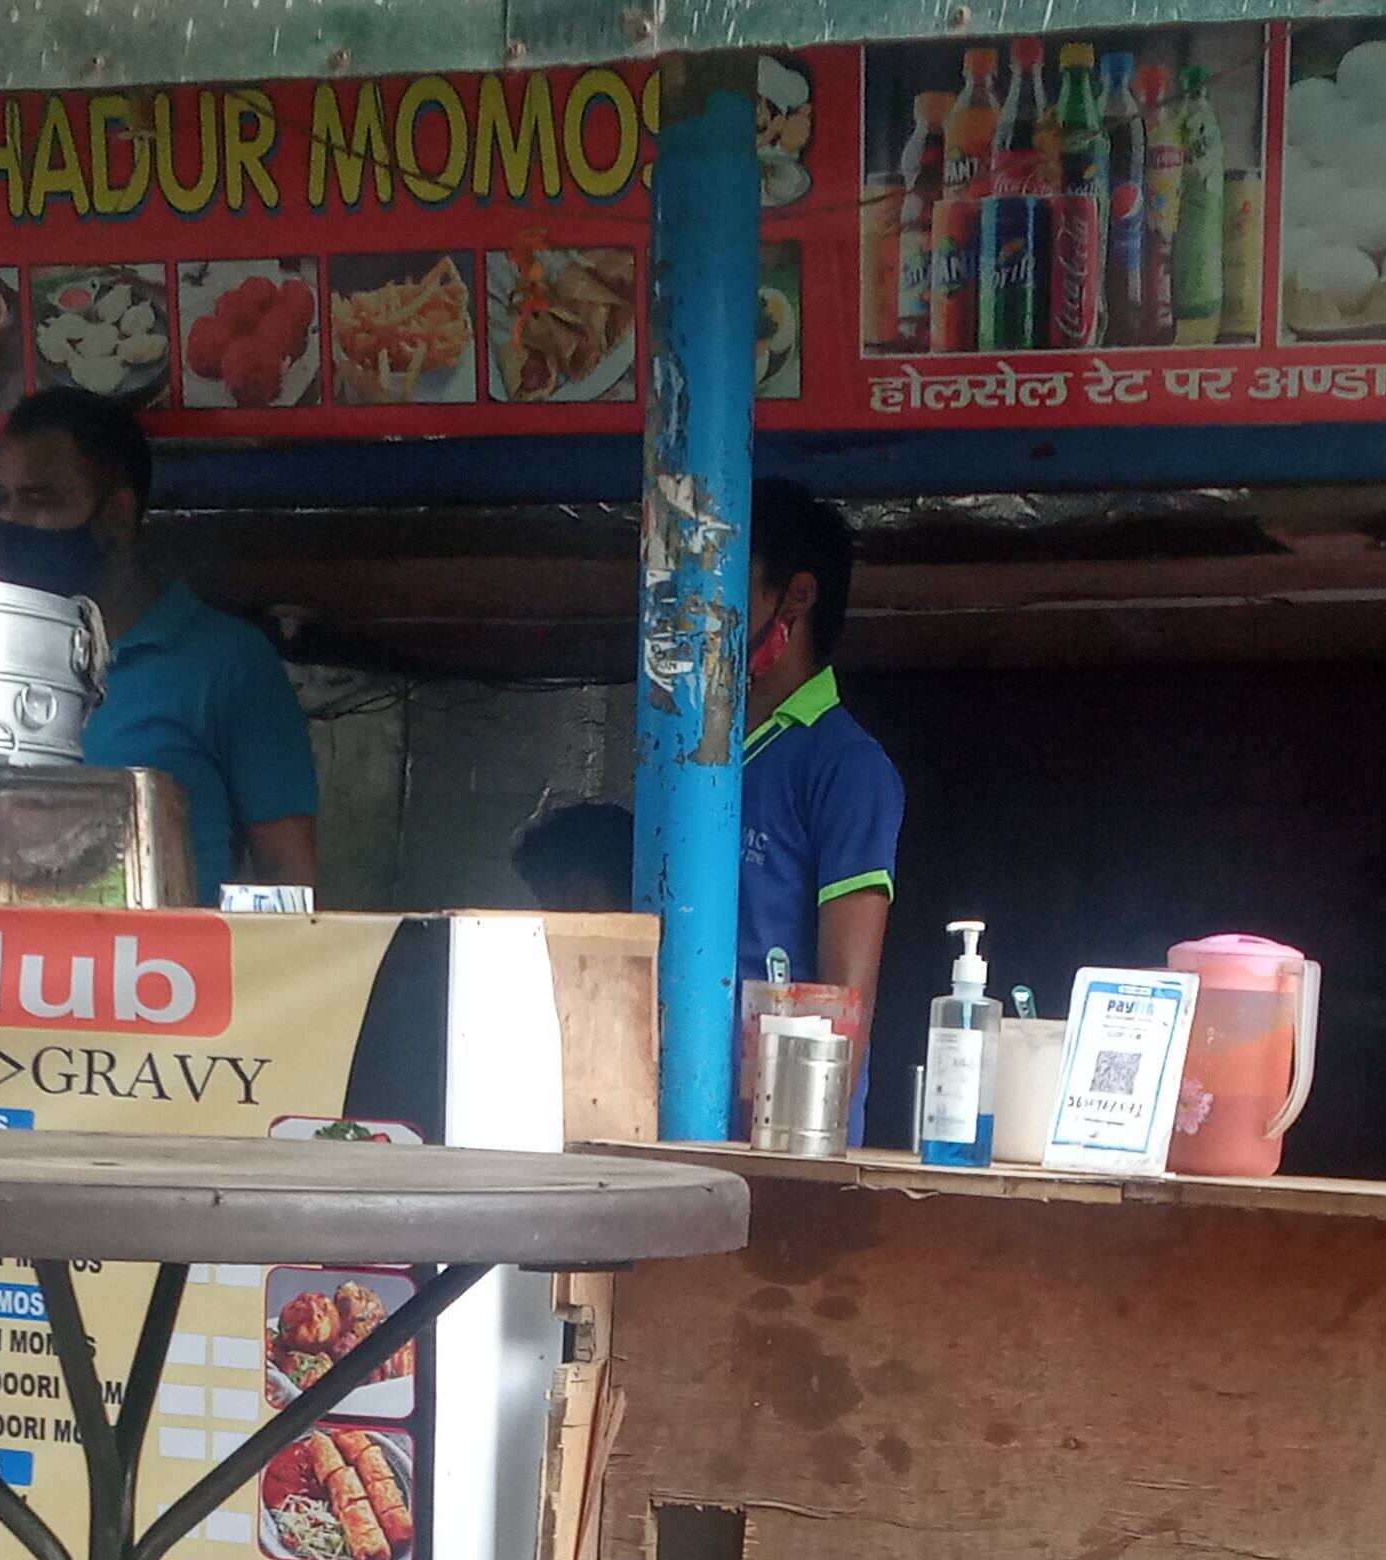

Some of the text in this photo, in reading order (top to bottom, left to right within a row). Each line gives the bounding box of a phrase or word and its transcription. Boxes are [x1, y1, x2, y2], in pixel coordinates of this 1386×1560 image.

[868, 360, 1073, 414] होलसेल
[1082, 357, 1151, 404] रेट
[1162, 366, 1238, 401] पर
